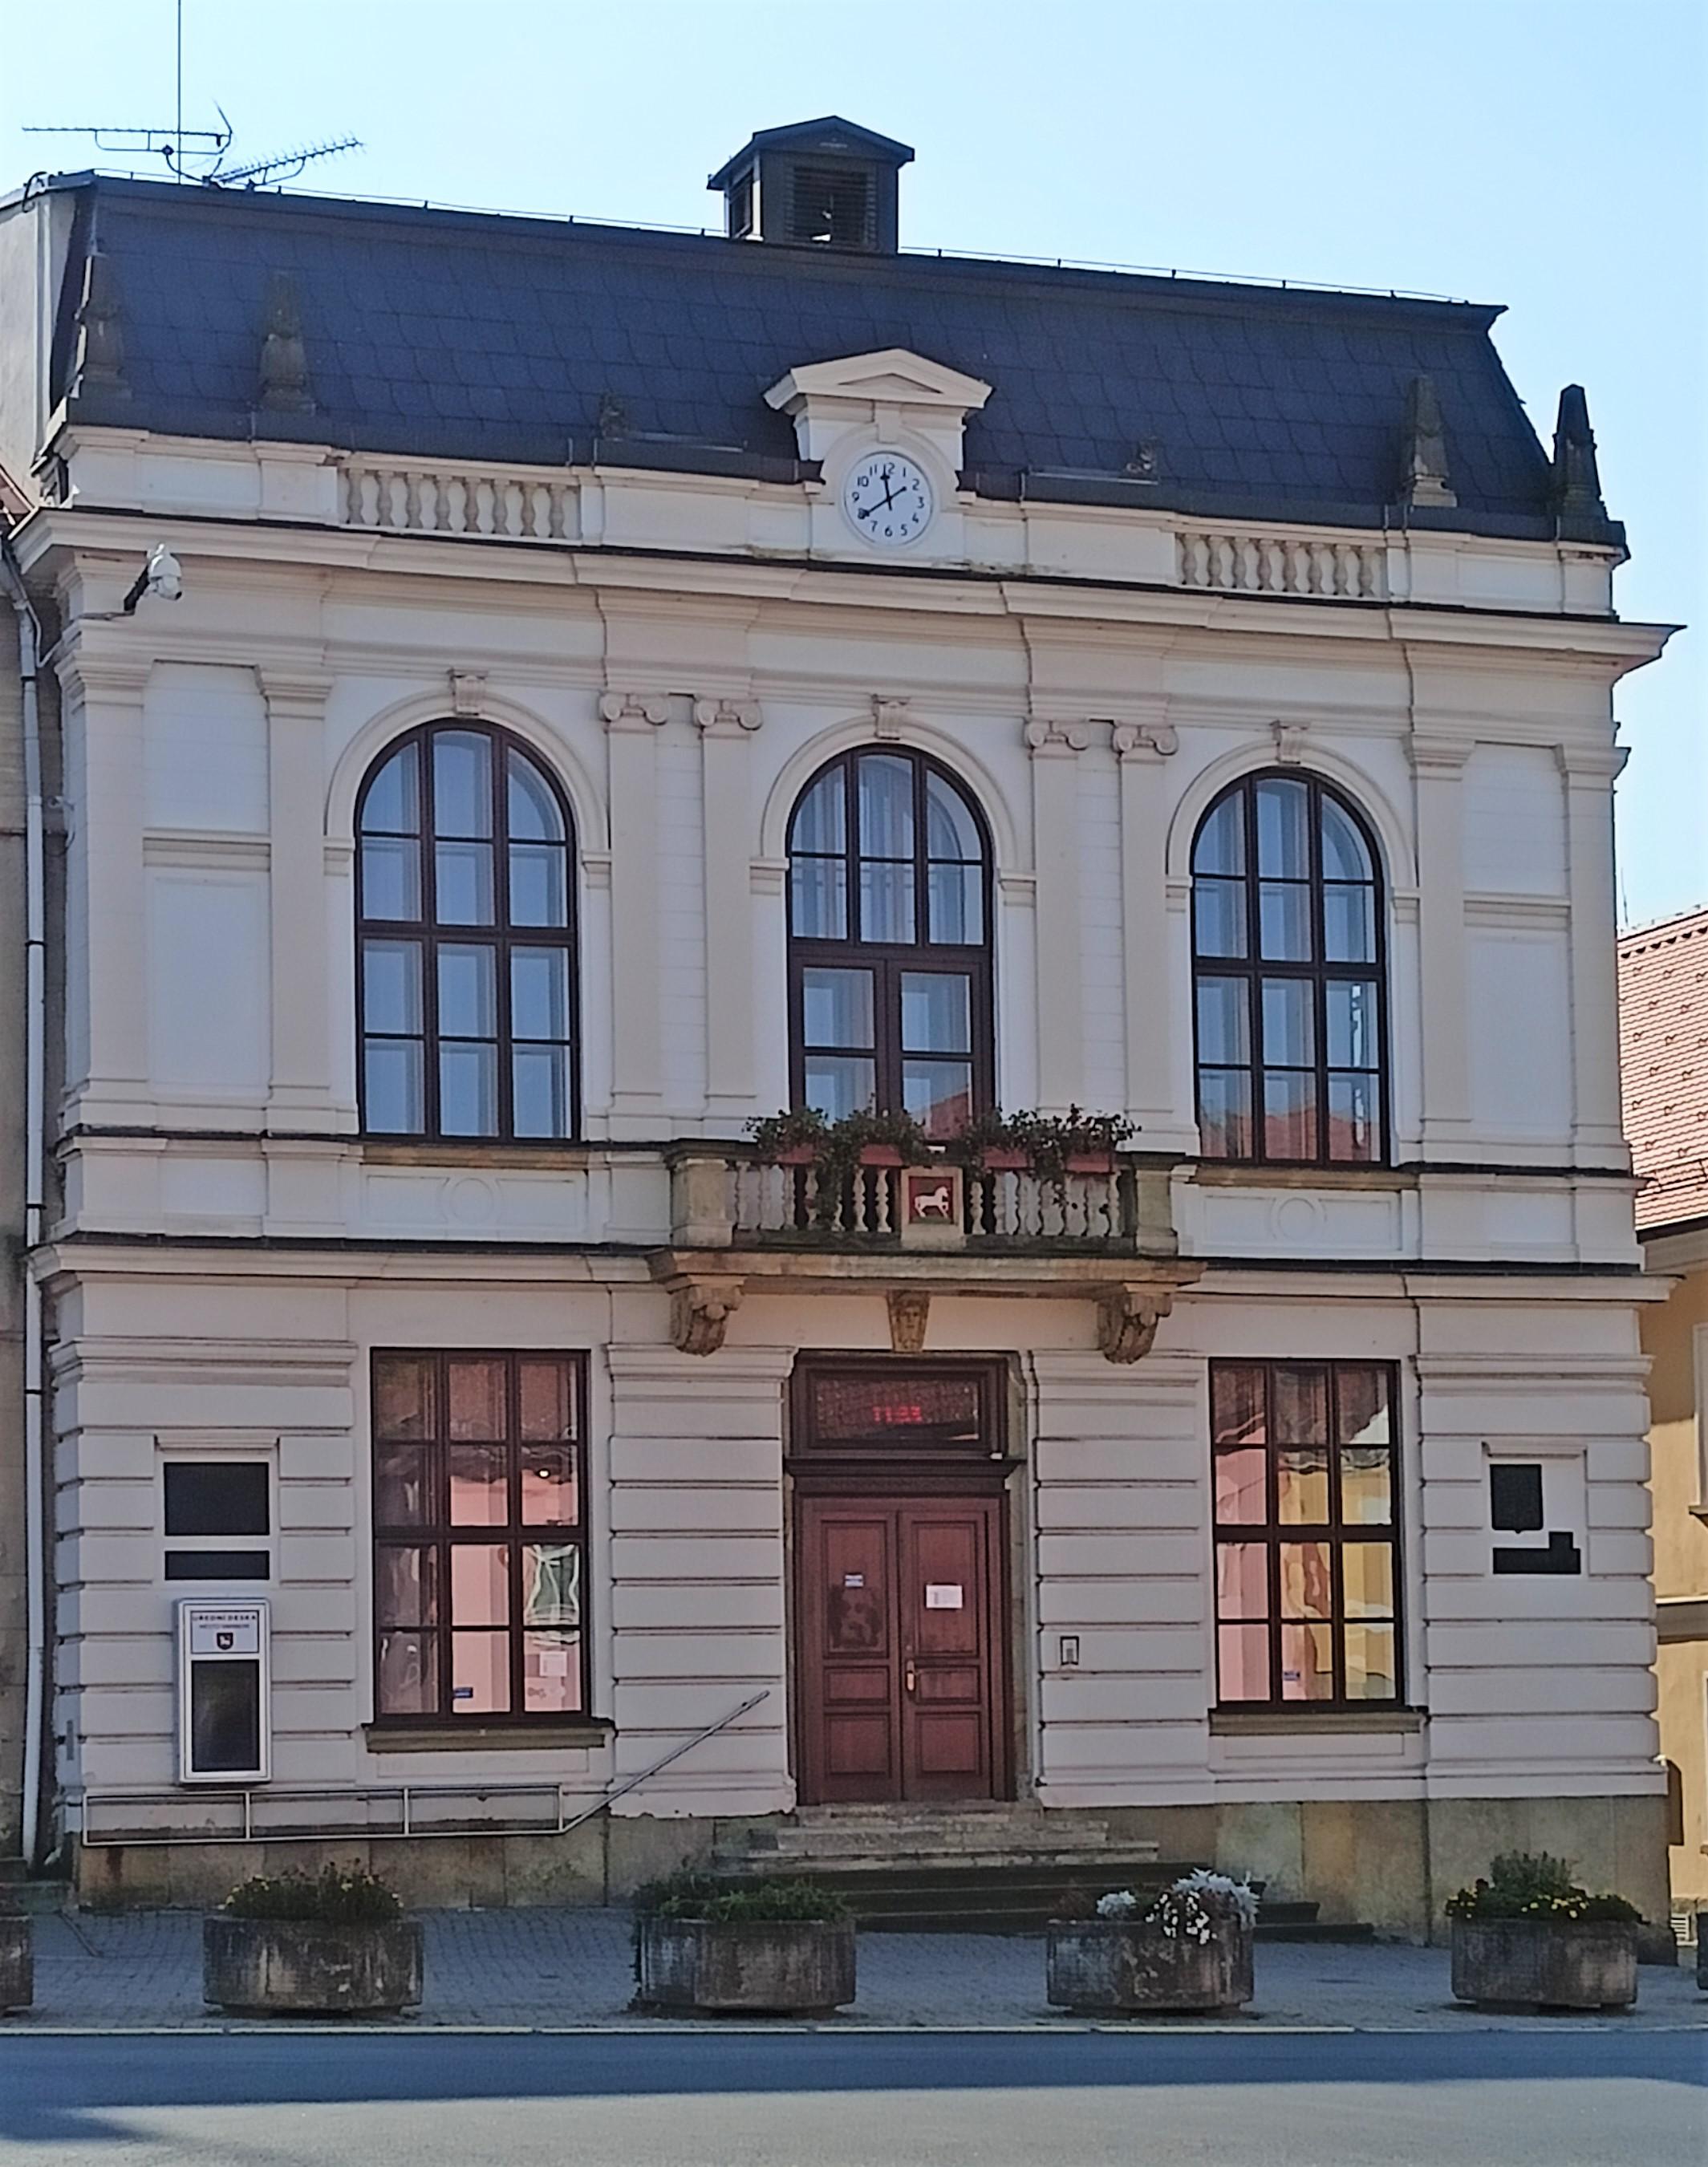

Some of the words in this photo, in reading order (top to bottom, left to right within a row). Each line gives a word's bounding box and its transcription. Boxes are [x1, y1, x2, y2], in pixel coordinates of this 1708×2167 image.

[869, 464, 877, 477] 11
[858, 475, 869, 487] 10
[912, 478, 919, 490] 2
[851, 491, 860, 503] 9
[917, 497, 924, 509] 3
[912, 513, 919, 523] 4
[870, 520, 878, 532] 7
[885, 526, 892, 537] 6
[900, 524, 907, 536] 5
